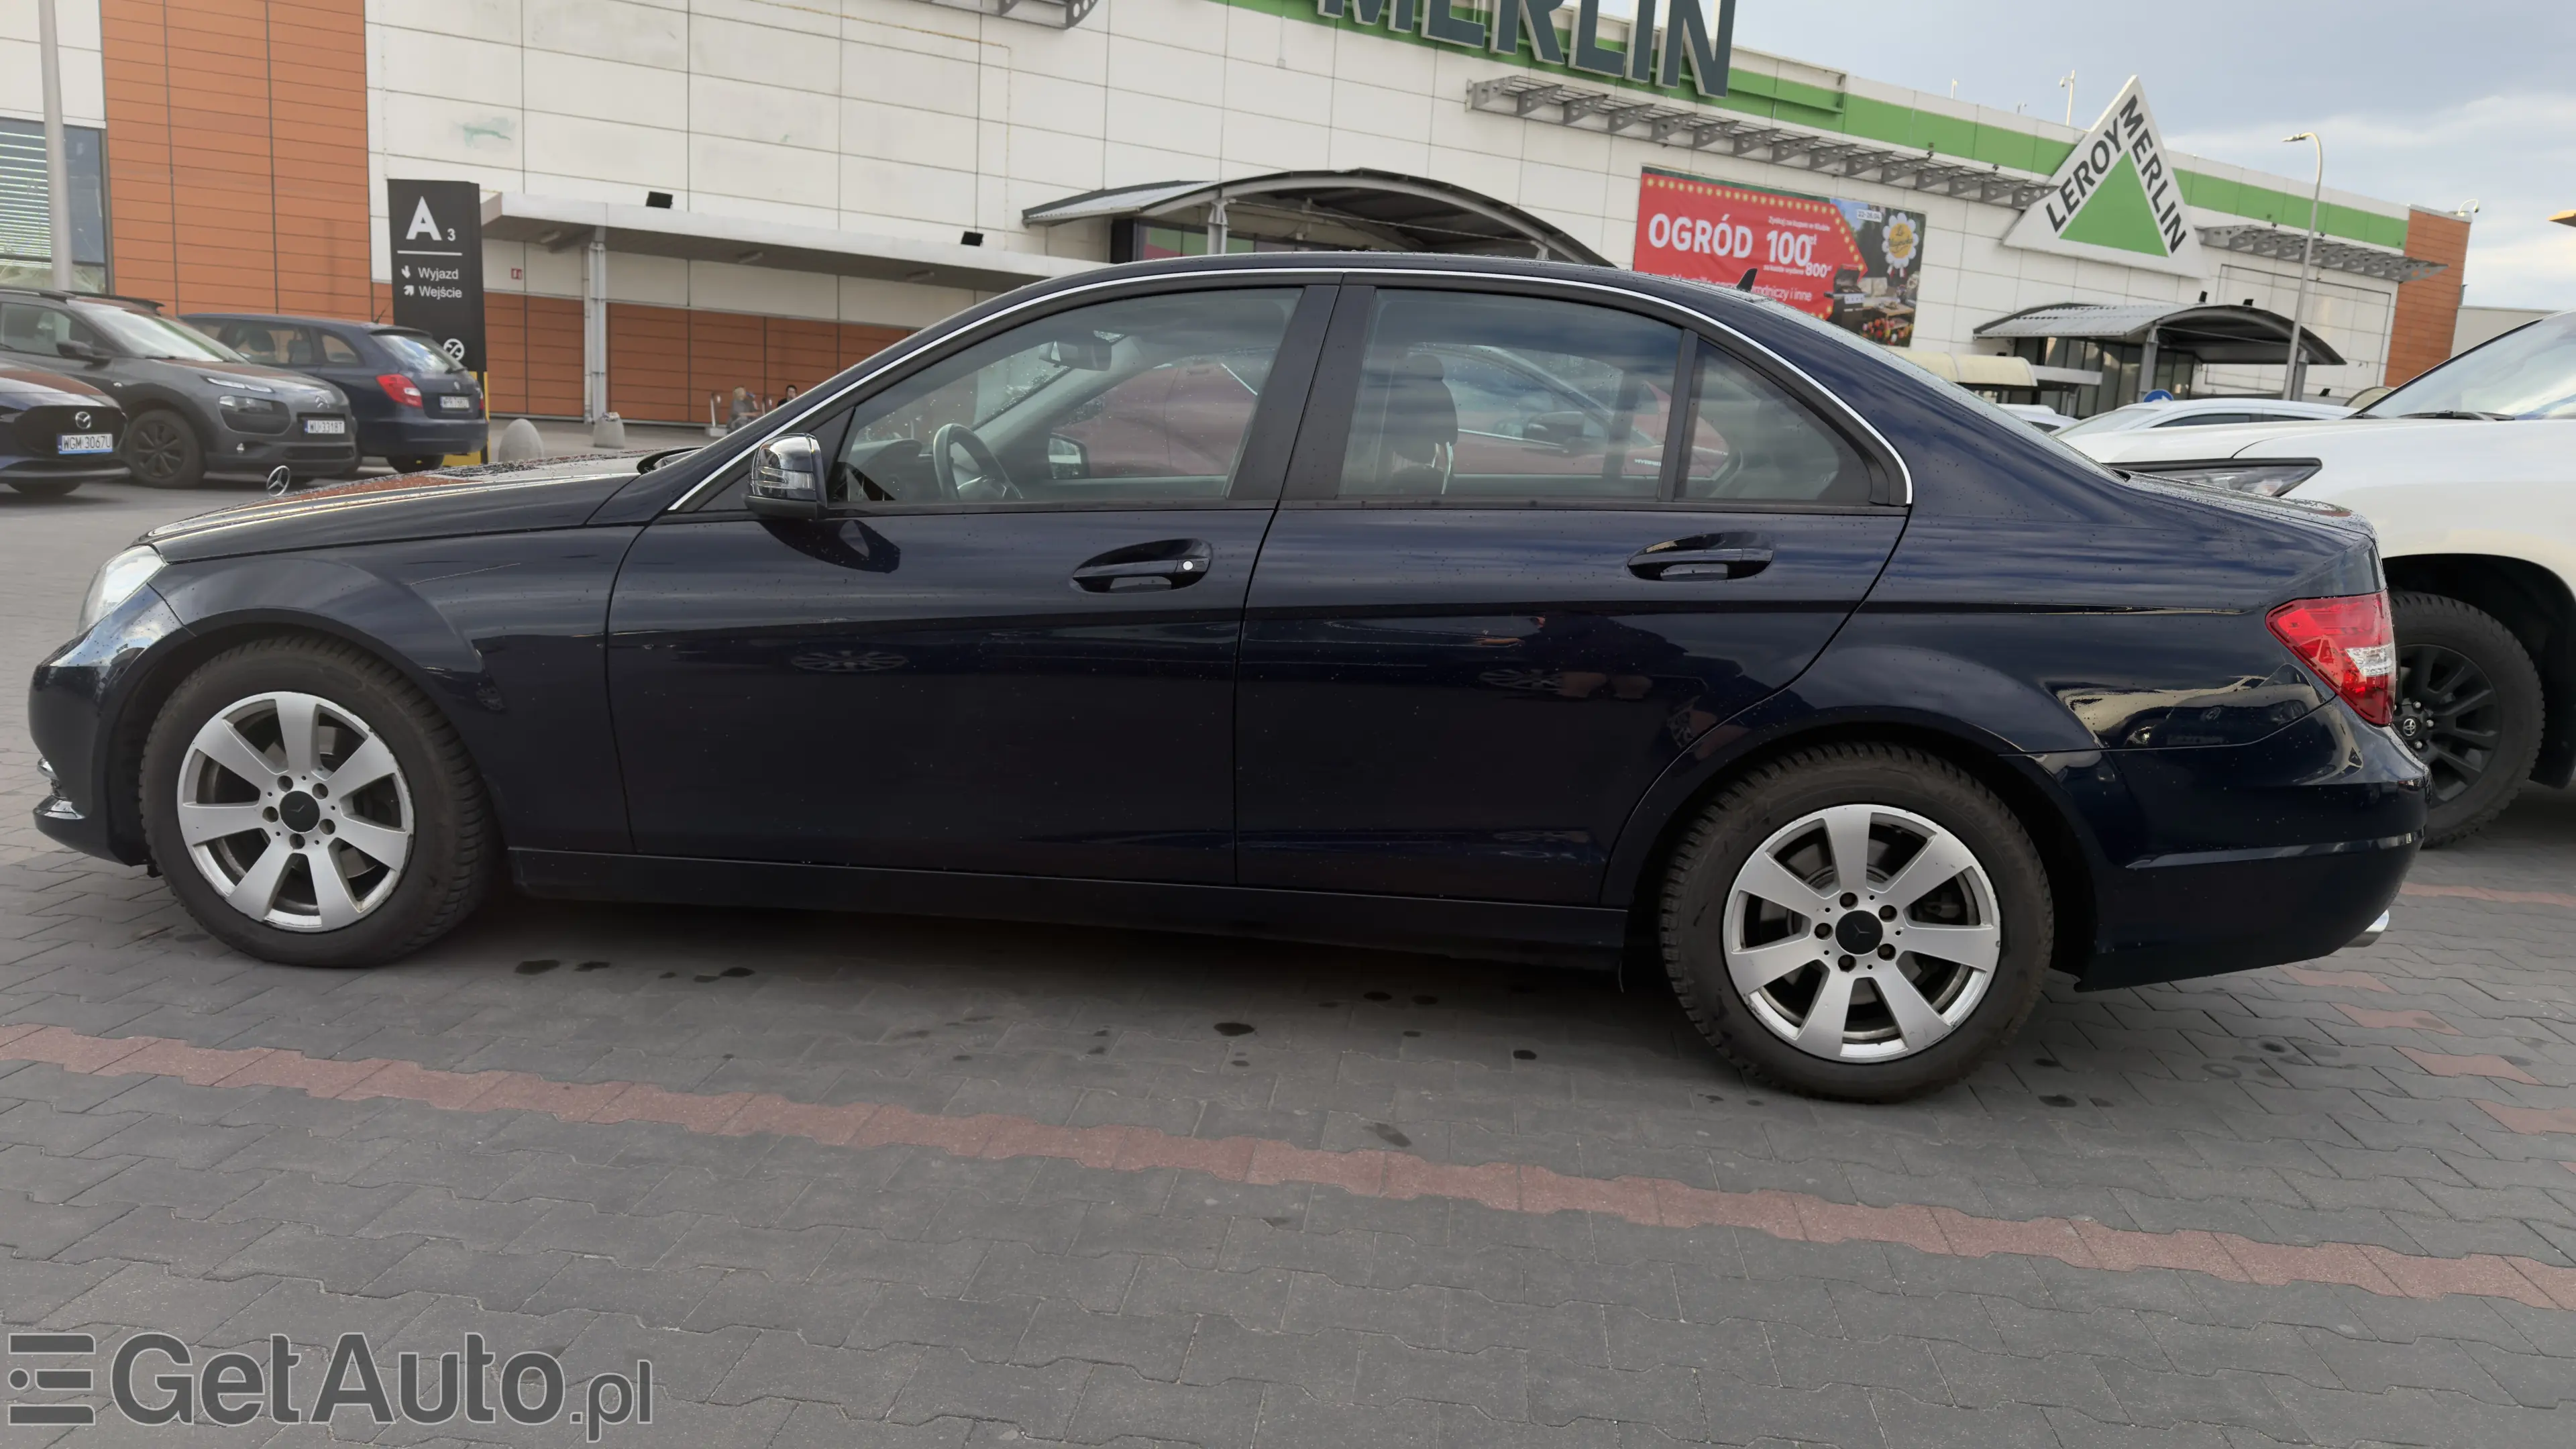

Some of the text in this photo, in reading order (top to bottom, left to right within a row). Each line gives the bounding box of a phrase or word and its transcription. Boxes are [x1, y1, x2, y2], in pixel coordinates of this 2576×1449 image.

[1318, 0, 1736, 99] RLIN
[2046, 116, 2122, 233] LEROY
[2119, 94, 2187, 254] MERLIN
[406, 196, 456, 241] A 3
[1648, 213, 1753, 258] OGRÓD
[1766, 230, 1812, 266] 100
[418, 267, 459, 281] Wyjazd
[1805, 262, 1827, 278] 800
[419, 286, 463, 300] Wejście
[64, 435, 111, 449] WGM 3067U
